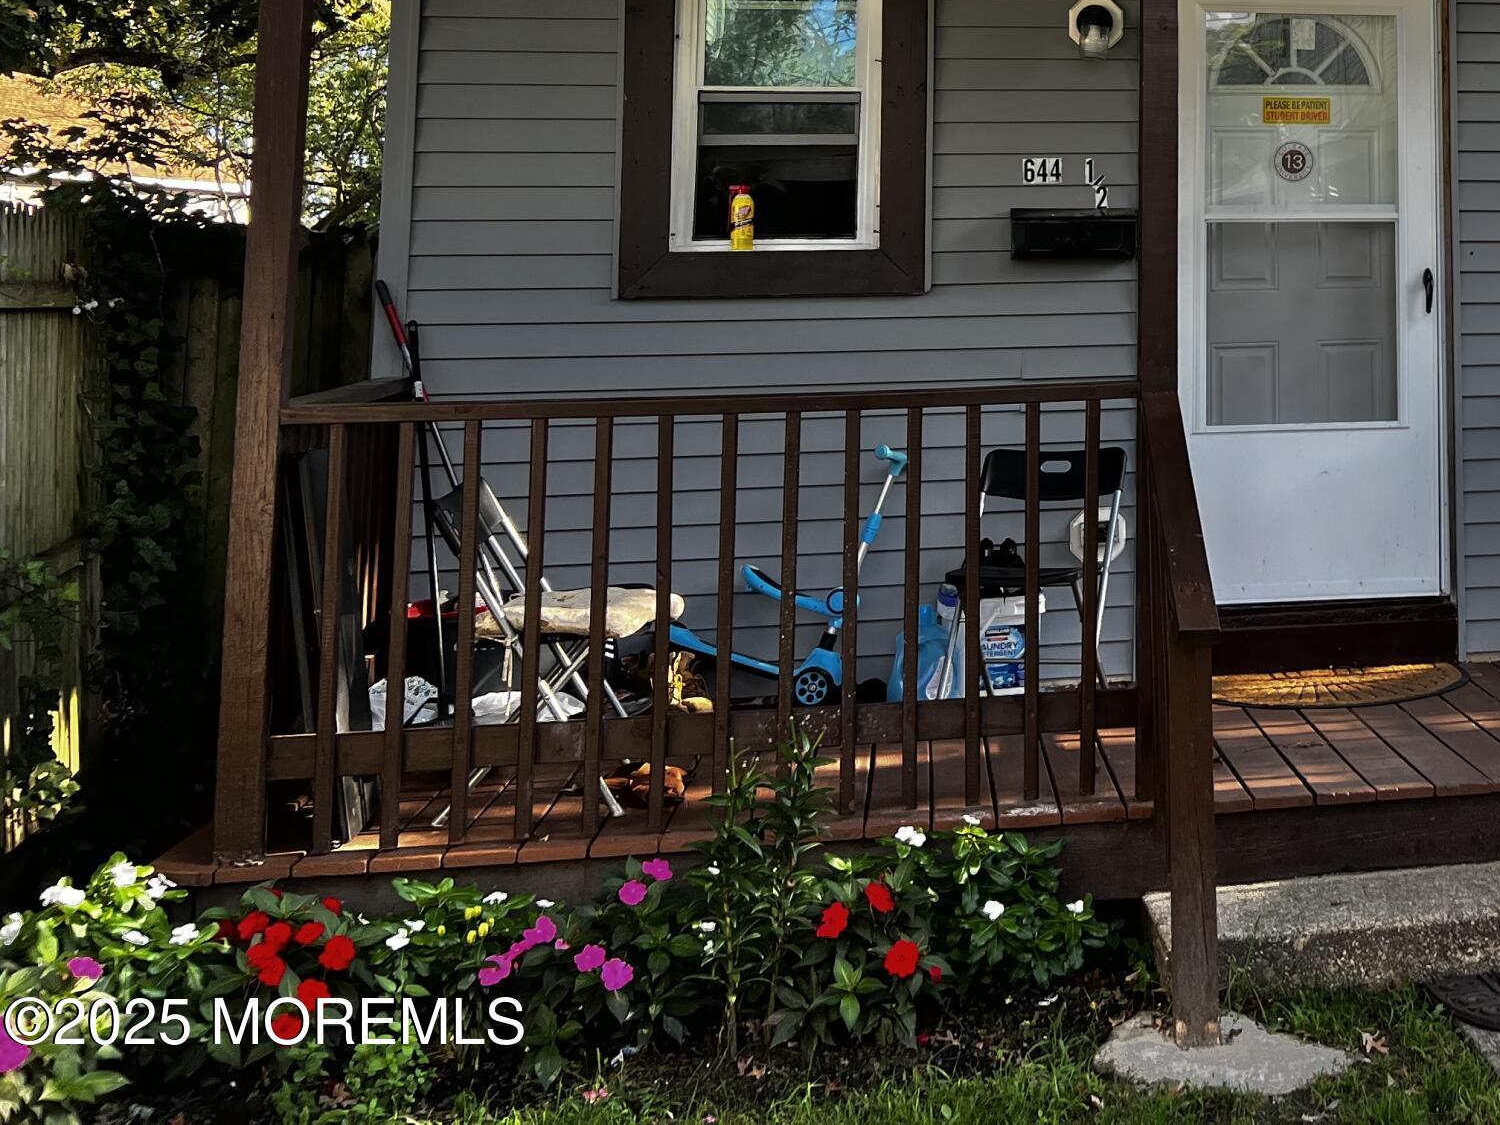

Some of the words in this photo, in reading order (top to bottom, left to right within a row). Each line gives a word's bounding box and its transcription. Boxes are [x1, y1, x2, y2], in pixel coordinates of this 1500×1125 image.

[1265, 100, 1290, 110] PLEASE
[1291, 100, 1300, 110] BE
[1301, 100, 1327, 110] PATIENT
[1265, 110, 1299, 121] STUDENT
[1300, 111, 1327, 121] DRIVER
[1285, 154, 1304, 170] 13
[1024, 158, 1061, 183] 644
[981, 642, 1018, 650] AUNDRY
